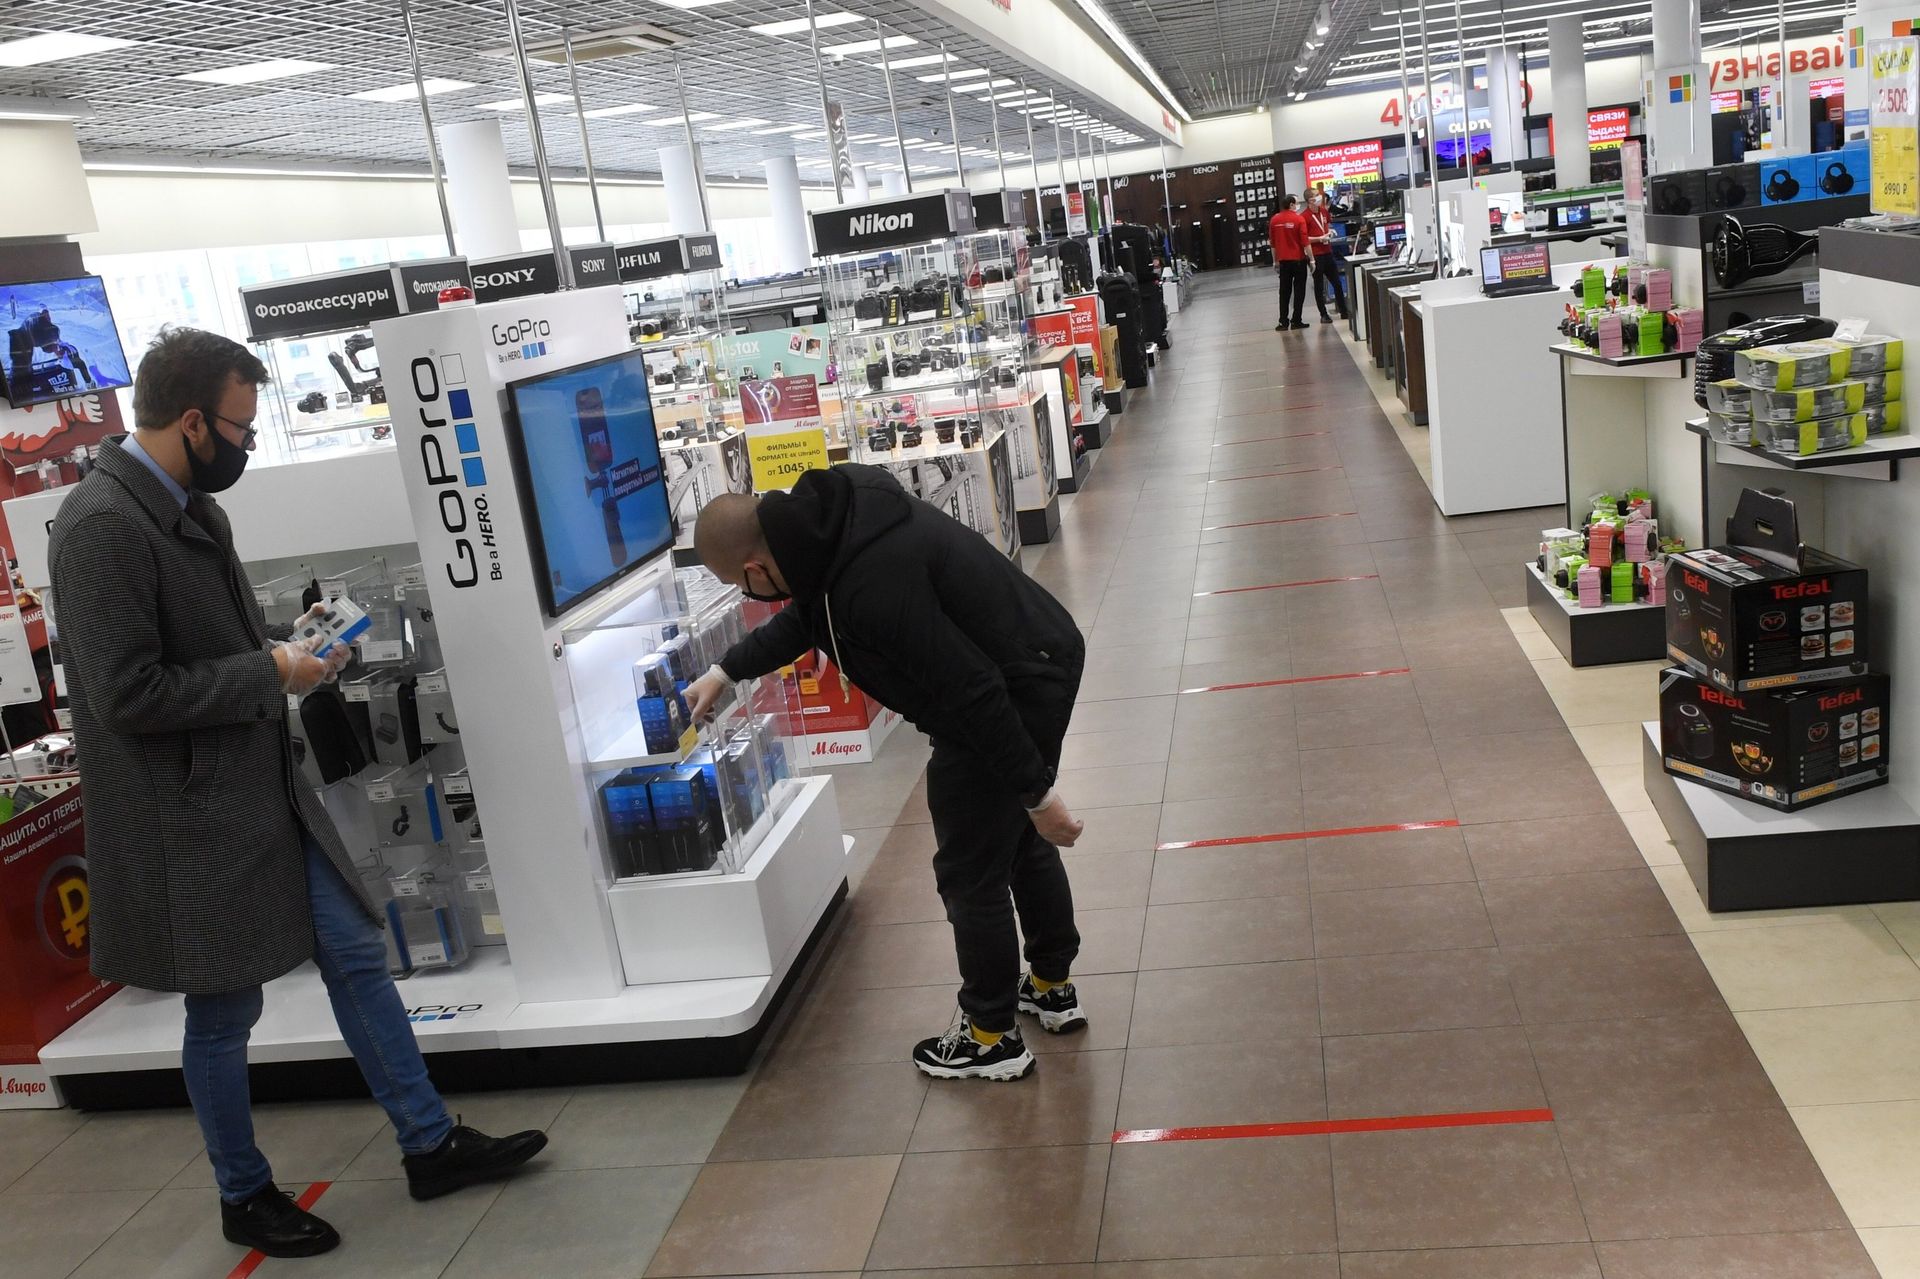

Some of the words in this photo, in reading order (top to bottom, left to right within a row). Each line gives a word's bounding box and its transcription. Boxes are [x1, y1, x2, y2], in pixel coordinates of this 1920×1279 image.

[1590, 111, 1625, 122] СВЯЗИ
[1308, 149, 1342, 160] САЛОН
[1344, 144, 1379, 155] СВЯЗИ
[1193, 165, 1219, 175] DENON
[849, 211, 914, 237] Nikon
[581, 258, 606, 274] SONY
[473, 267, 536, 290] SONY
[255, 288, 389, 319] Фотоаксессуары
[492, 319, 551, 346] GoPro
[766, 441, 801, 451] ФИЛЬМЫ
[757, 451, 788, 461] ФОРМАТЕ
[411, 356, 479, 589] GoPro
[777, 462, 805, 474] 1045
[474, 493, 497, 548] HERO.
[490, 552, 499, 560] a
[490, 562, 503, 581] Be
[1682, 568, 1710, 595] Tefal
[1770, 578, 1832, 600] Tefal
[23, 610, 44, 624] КАМЕ
[1747, 675, 1796, 688] EFFECTUAL
[1697, 685, 1746, 710] Tefal
[1818, 688, 1864, 711] Tefal
[811, 742, 862, 756] М.видео
[0, 821, 37, 850] АЩИТА
[38, 813, 51, 830] ОТ
[53, 796, 82, 821] ПЕРЕП
[3, 848, 28, 865] Нашли
[405, 1003, 483, 1016] Pro
